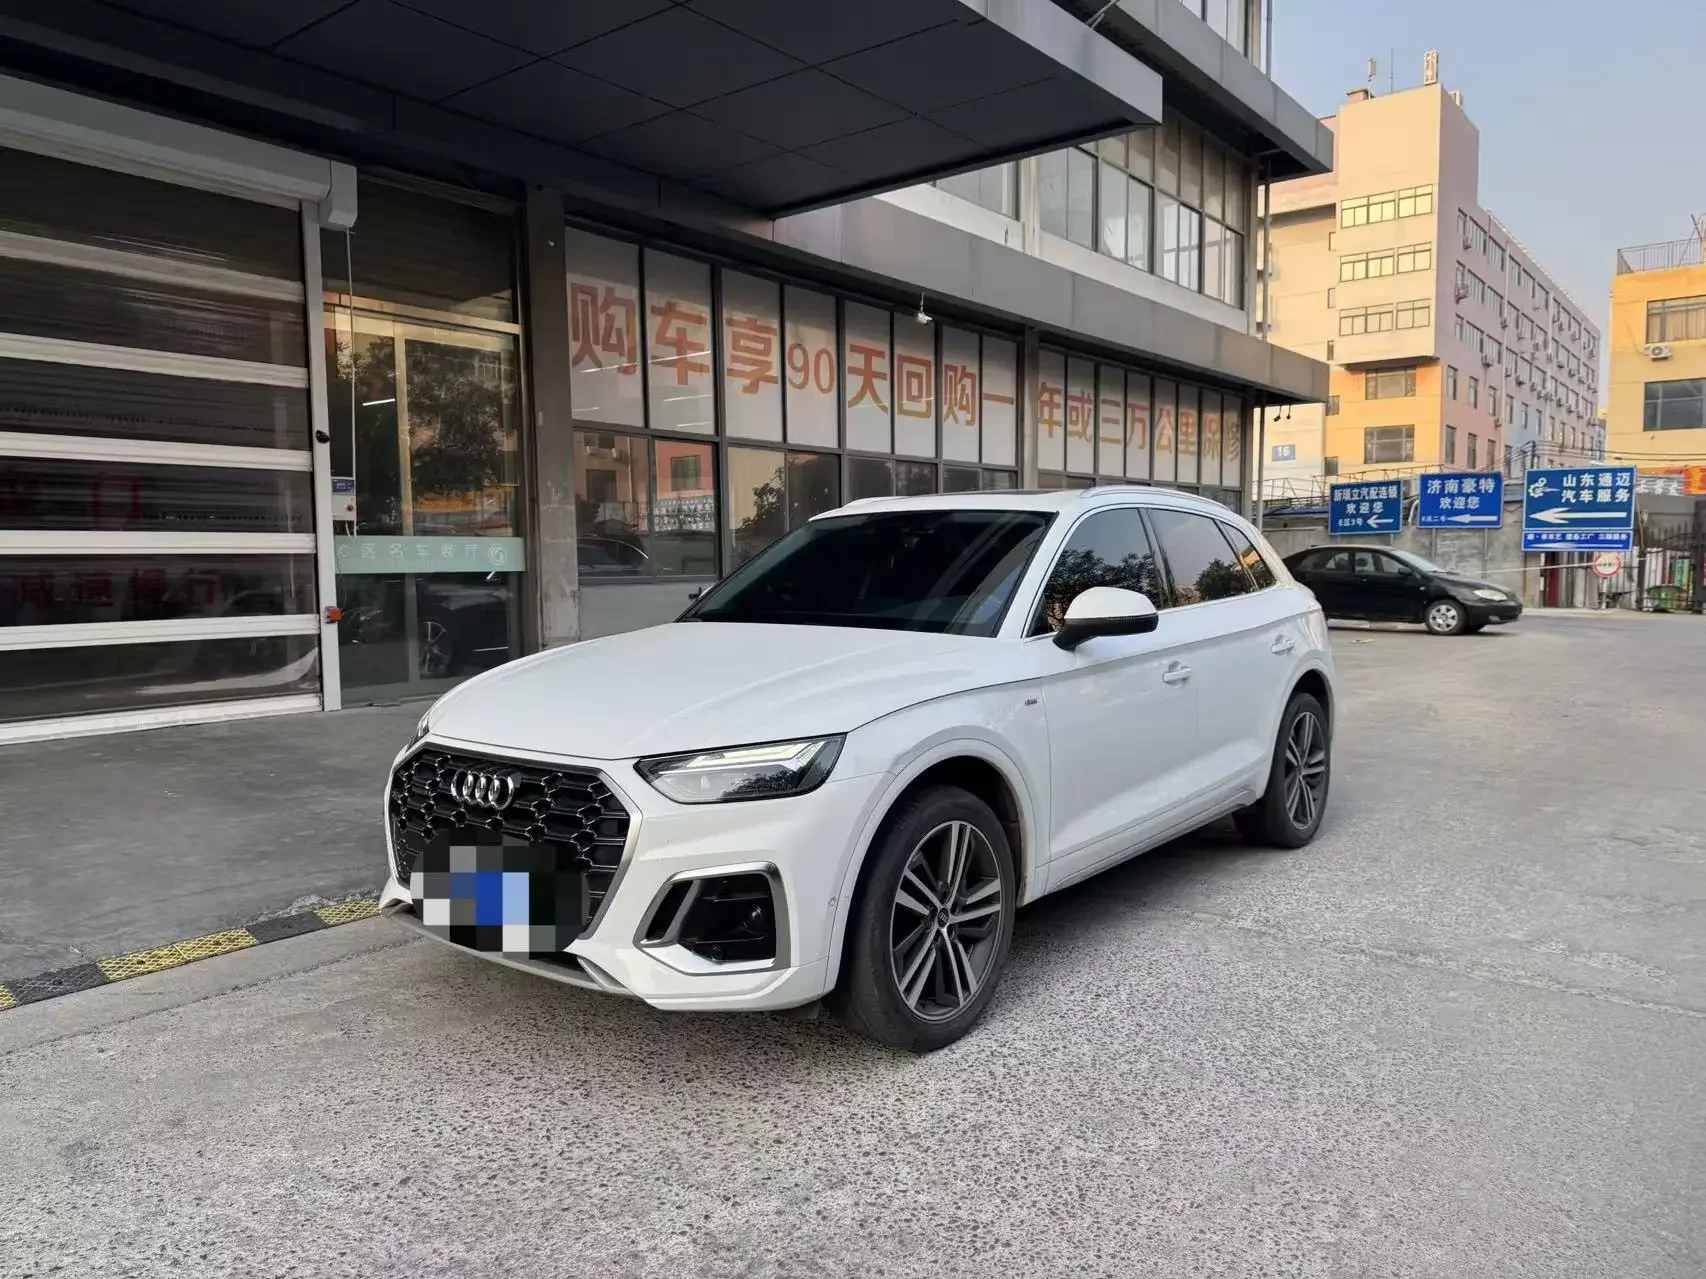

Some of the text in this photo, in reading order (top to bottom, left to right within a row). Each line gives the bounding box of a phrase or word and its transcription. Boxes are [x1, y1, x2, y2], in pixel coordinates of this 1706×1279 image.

[1426, 477, 1496, 494] 济南豪特
[1562, 471, 1631, 488] 山东通迈
[1439, 496, 1480, 510] 欢迎您
[1561, 488, 1631, 503] 汽车服务
[1346, 501, 1384, 514] 欢迎您
